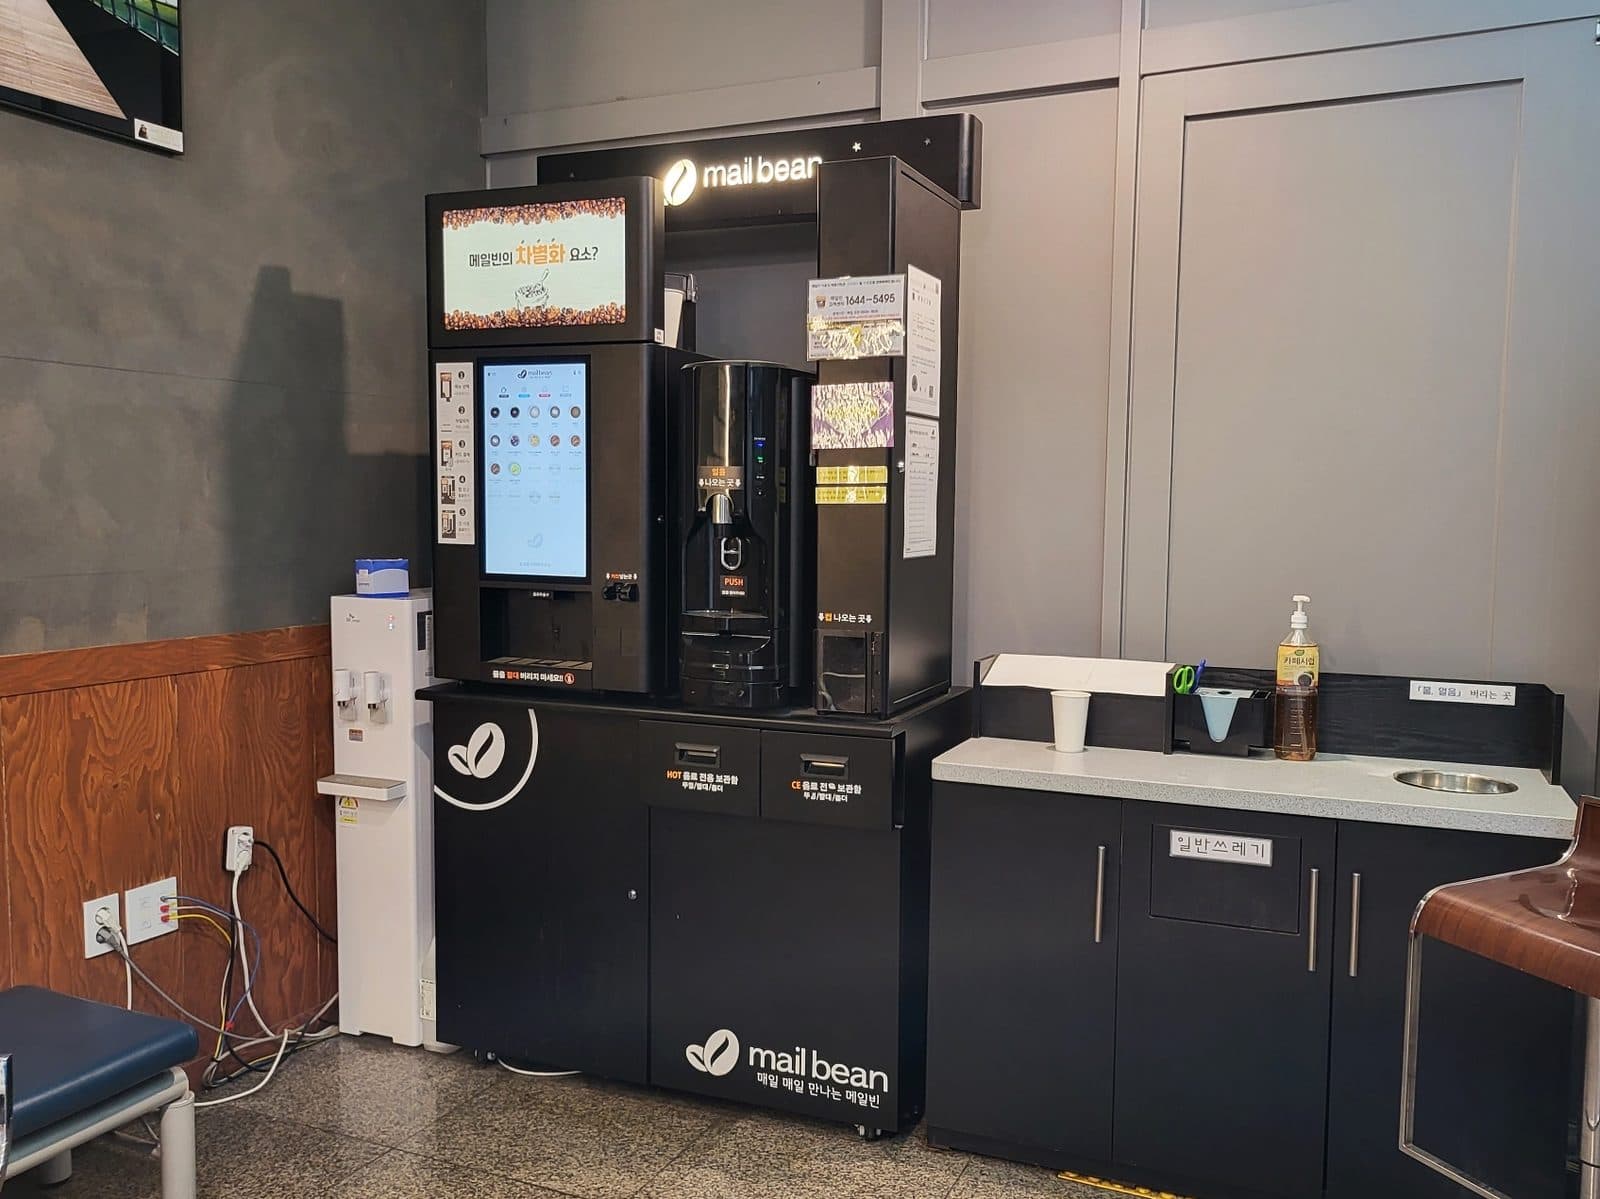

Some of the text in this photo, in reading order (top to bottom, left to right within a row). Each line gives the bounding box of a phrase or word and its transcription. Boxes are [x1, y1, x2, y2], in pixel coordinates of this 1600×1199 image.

[703, 156, 753, 188] mail
[468, 241, 599, 268] 메일빈의 차별화 요소?
[845, 293, 896, 306] 1644-5495
[704, 478, 735, 488] 나오는 곳
[724, 577, 744, 586] PUSH
[833, 613, 857, 623] 나오는
[857, 614, 866, 623] 곳
[1284, 656, 1315, 666] 카페시럽
[520, 671, 540, 681] 버리지
[1470, 689, 1498, 700] 버리는
[1503, 690, 1512, 701] 곳
[666, 770, 682, 779] HOT
[699, 772, 714, 783] 전용
[715, 774, 739, 785] 보관함
[837, 784, 862, 795] 보관함
[1177, 836, 1265, 859] 일반쓰레기
[749, 1046, 888, 1093] mail bean
[757, 1072, 880, 1109] 매일 매일 만나는 메일빈
